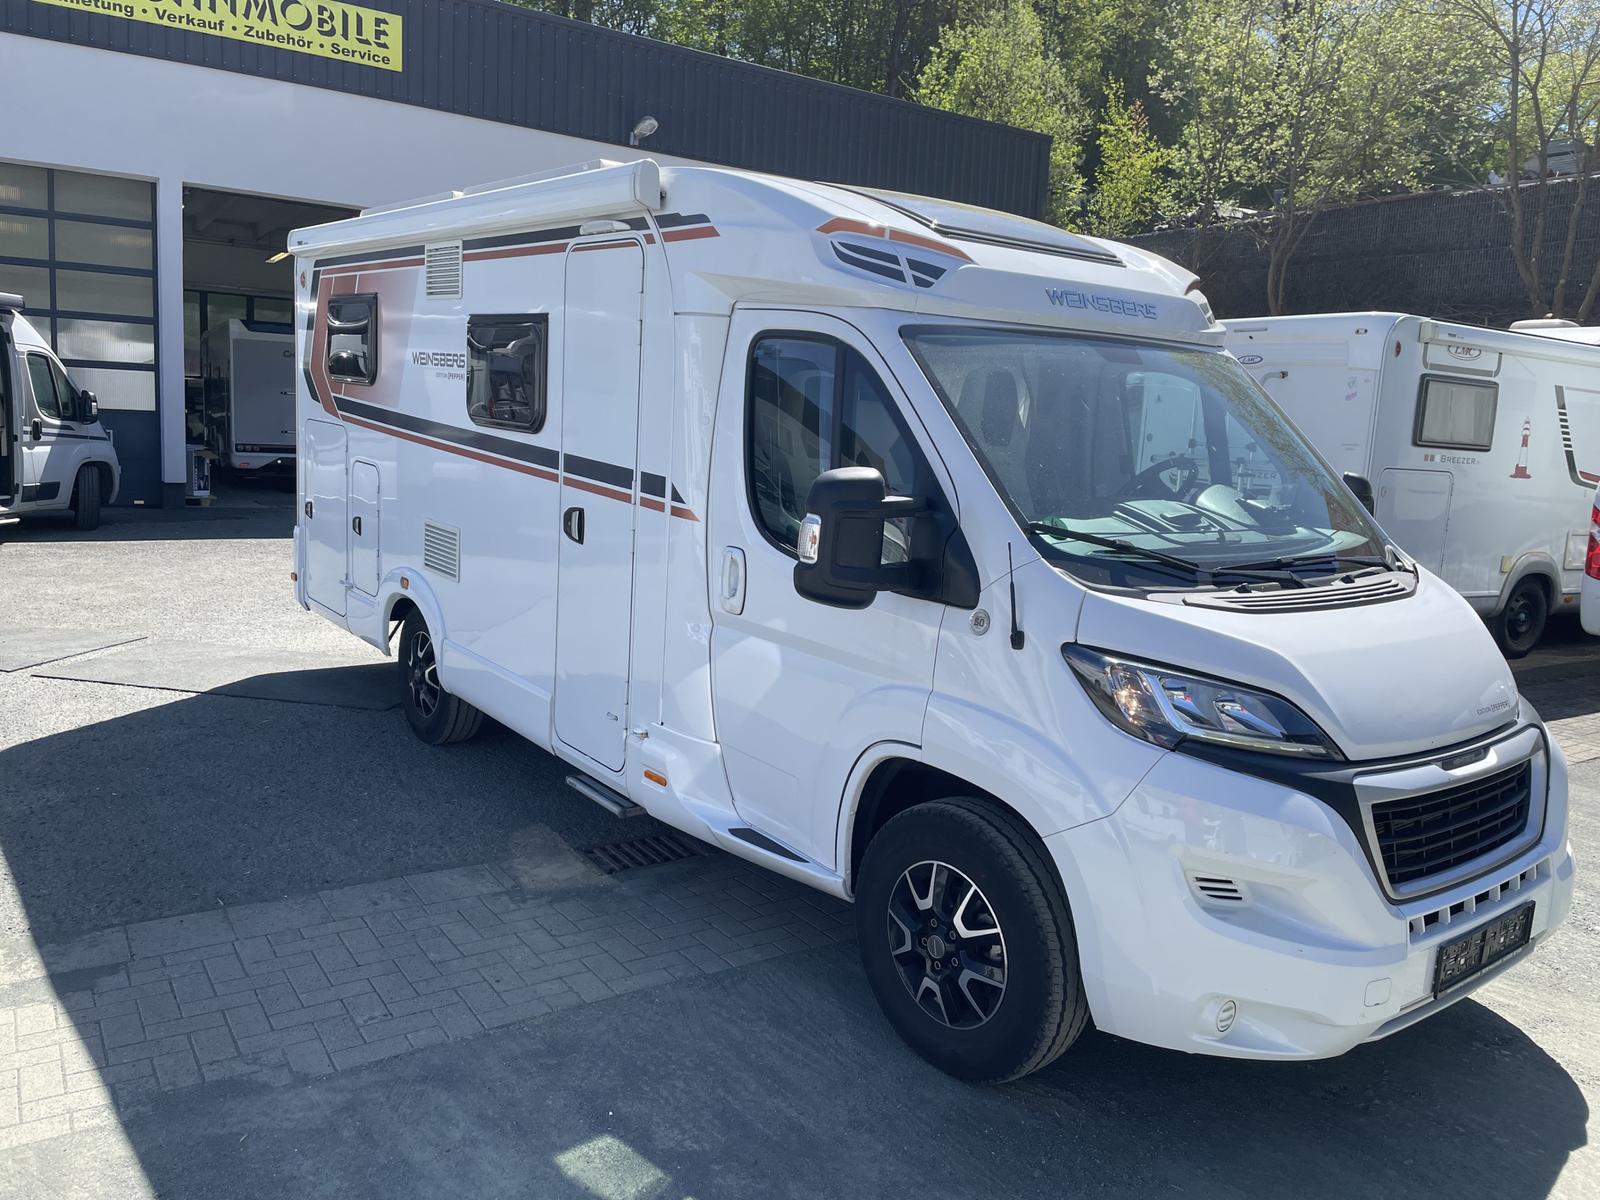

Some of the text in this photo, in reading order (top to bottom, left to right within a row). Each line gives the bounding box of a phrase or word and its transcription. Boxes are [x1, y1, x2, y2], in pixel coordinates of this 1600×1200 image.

[154, 7, 224, 32] Verkauf
[243, 25, 313, 49] Zubehör
[331, 42, 391, 65] Service
[1044, 287, 1158, 320] WEINSBERG
[411, 351, 466, 368] WEINSBERG
[1440, 454, 1476, 465] BREEZER
